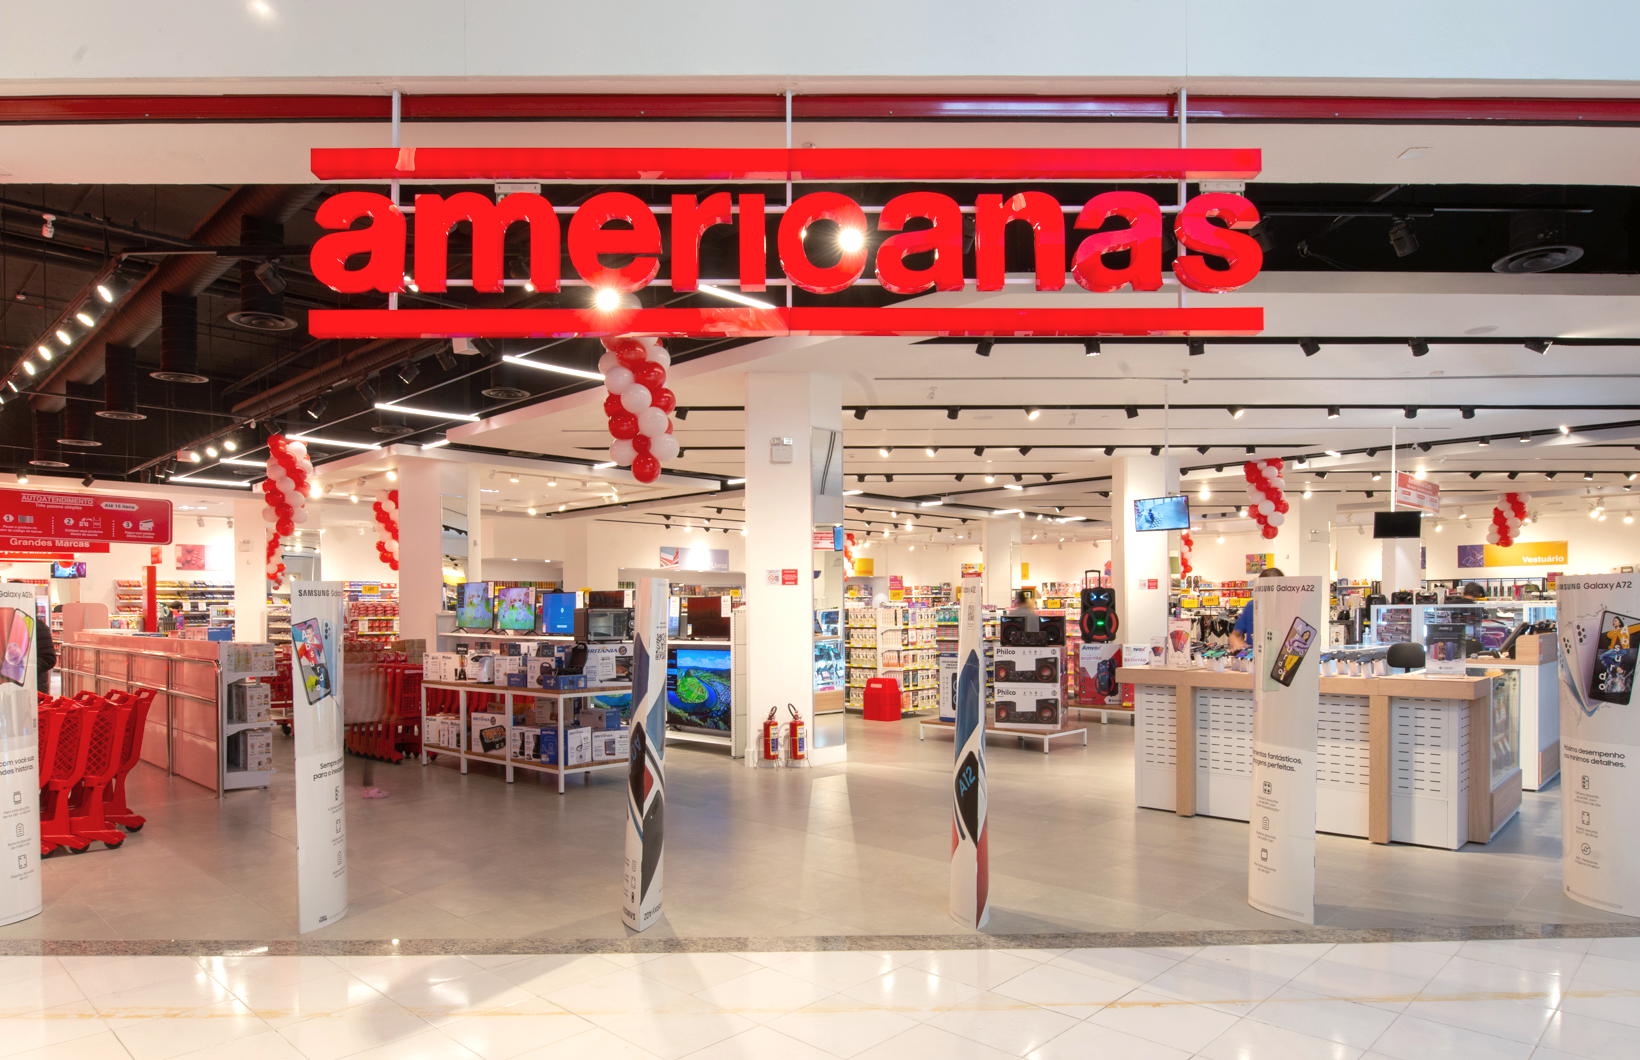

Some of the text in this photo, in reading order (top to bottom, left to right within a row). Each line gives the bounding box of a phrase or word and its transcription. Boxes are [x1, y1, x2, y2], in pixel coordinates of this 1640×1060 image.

[310, 191, 1264, 293] americanas
[22, 495, 93, 504] AUTOATENDIMENTO
[10, 538, 90, 548] Grandes Marcas
[1522, 555, 1565, 563] Vestuário
[1276, 584, 1300, 593] Galaxy
[1301, 584, 1315, 592] A22
[1583, 582, 1614, 591] Galaxy
[1615, 581, 1633, 589] A72
[298, 589, 330, 597] SAMSUNG
[997, 688, 1017, 696] Philco
[1578, 747, 1625, 760] desempenho
[14, 756, 27, 765] você
[1590, 758, 1626, 768] detalhes.
[1267, 761, 1297, 772] perfeitas.
[312, 771, 328, 782] para
[957, 765, 976, 797] A12
